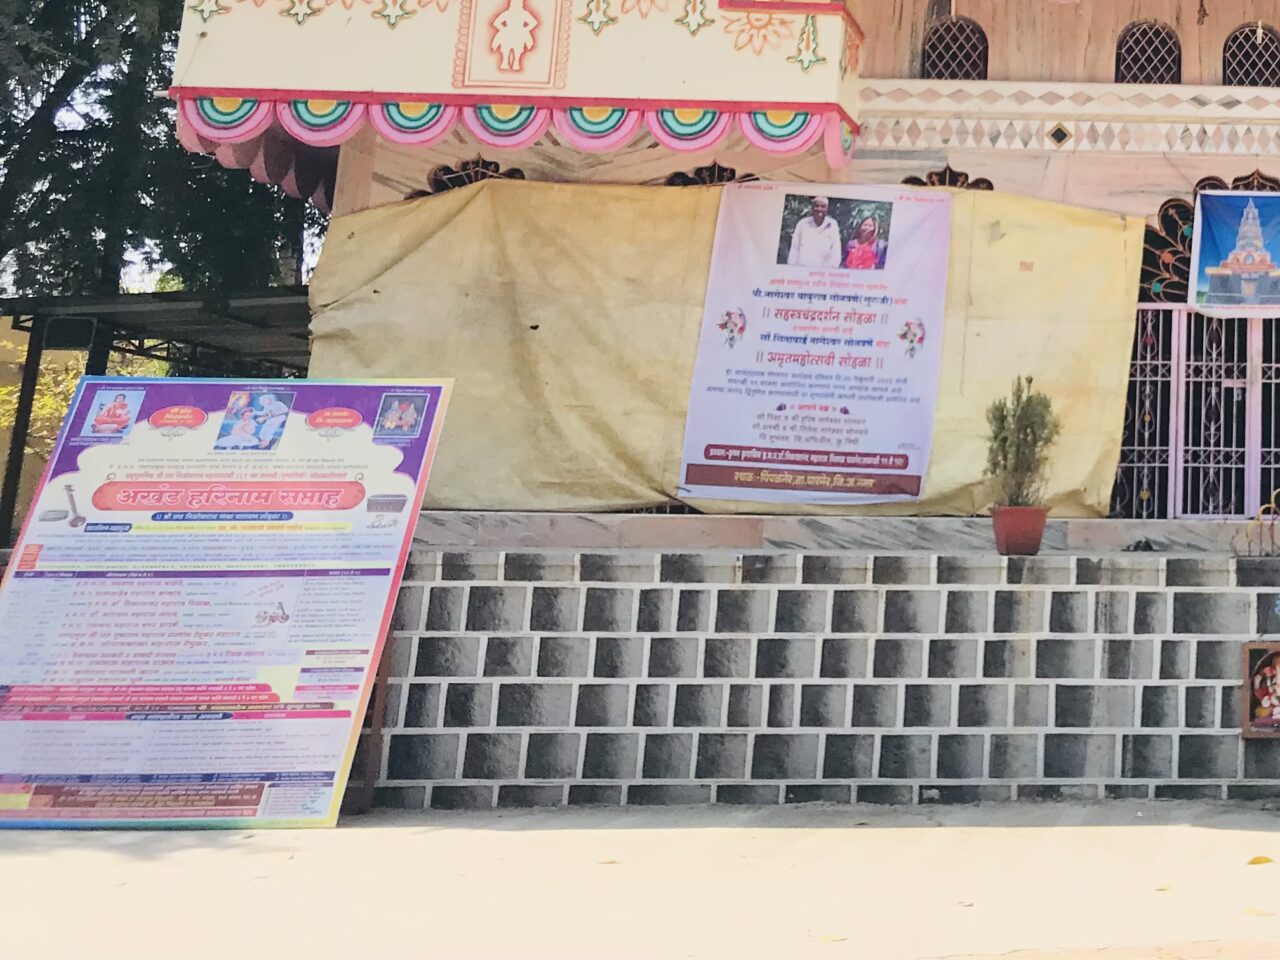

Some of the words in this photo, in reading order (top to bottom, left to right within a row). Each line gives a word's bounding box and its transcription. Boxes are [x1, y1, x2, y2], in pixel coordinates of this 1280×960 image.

[844, 308, 877, 323] सोहळा
[839, 352, 872, 369] सोहळा
[117, 485, 183, 506] अखंड
[187, 485, 274, 507] हरिनाम
[278, 488, 343, 507] सप्ताह
